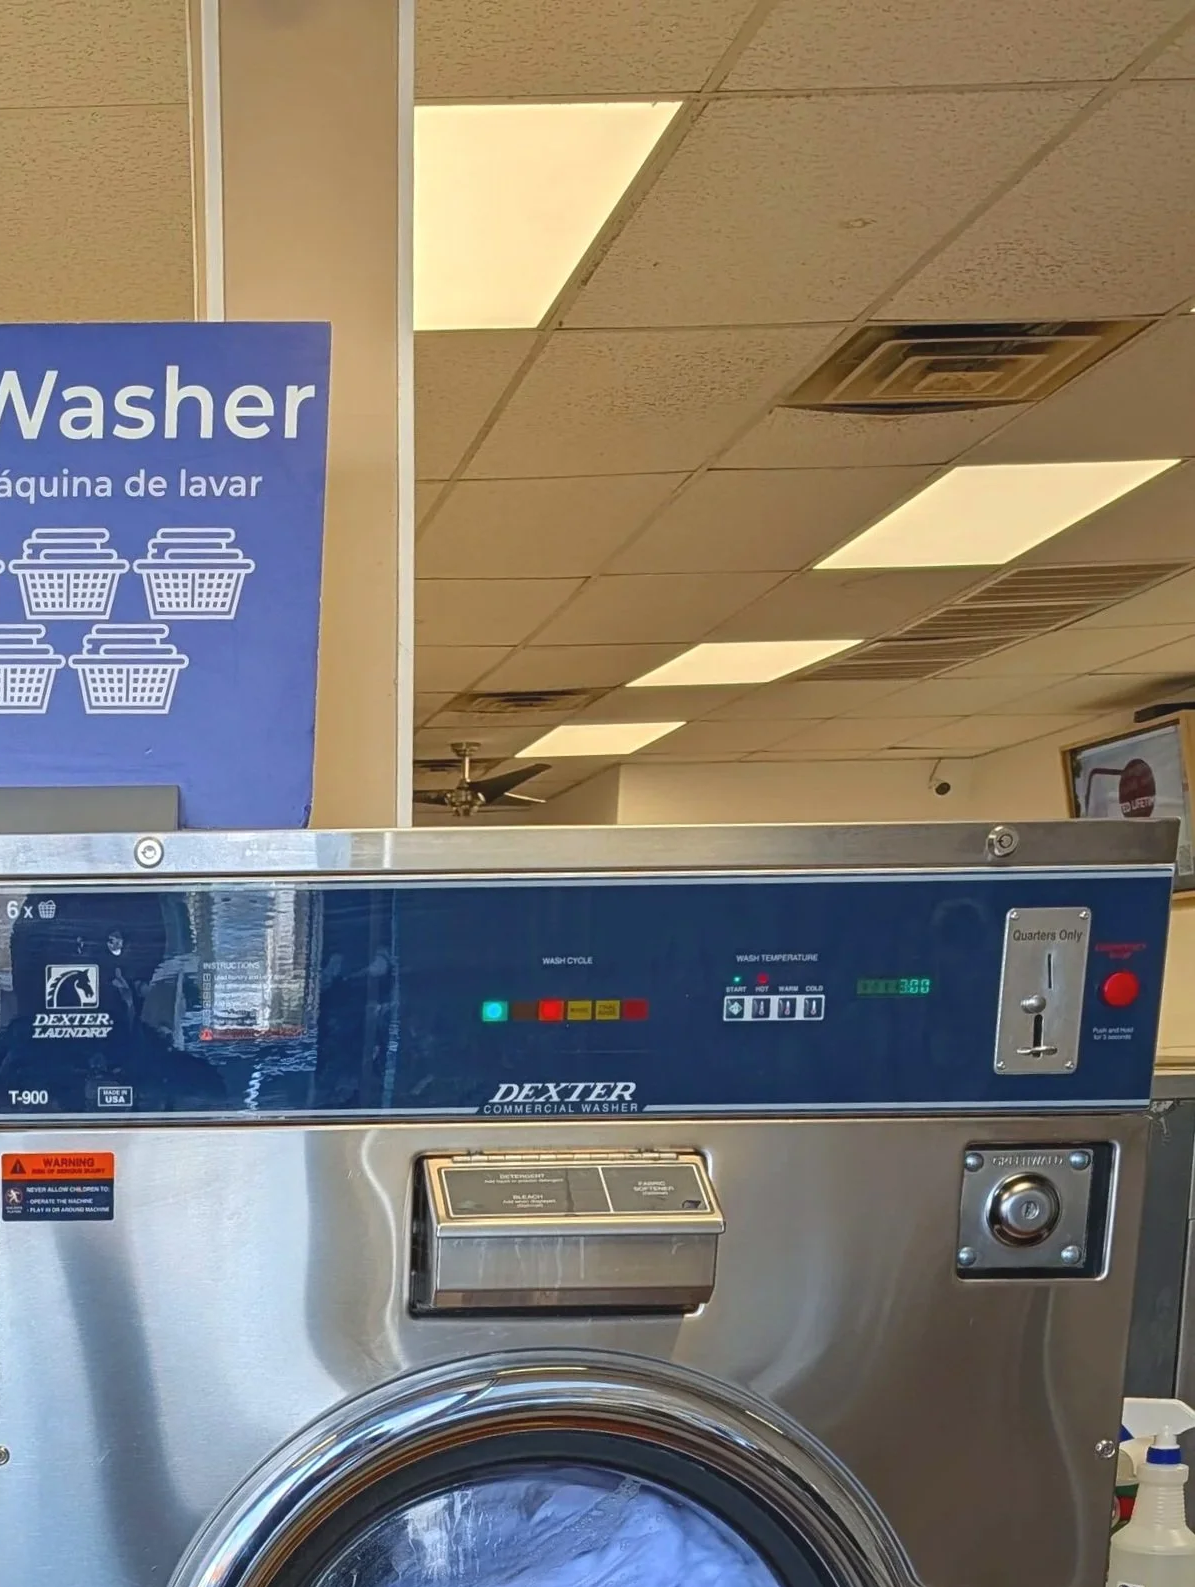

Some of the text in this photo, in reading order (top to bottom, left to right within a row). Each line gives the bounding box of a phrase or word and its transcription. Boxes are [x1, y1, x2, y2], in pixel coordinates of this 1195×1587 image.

[125, 469, 167, 498] de
[179, 469, 263, 498] lavar
[7, 900, 33, 919] 6 x
[1013, 929, 1083, 942] Quarters Only
[542, 957, 593, 965] WASH CYCLE
[736, 954, 819, 962] WASH TEMPERATURE
[202, 962, 260, 970] INSTRUCTIONS
[32, 1013, 109, 1026] DEXTER
[32, 1027, 113, 1039] LAUNDRY
[9, 1090, 48, 1105] T-900
[488, 1082, 637, 1103] DEXTER
[105, 1096, 125, 1104] USA
[483, 1103, 638, 1114] COMMERCIAL WASHER
[43, 1158, 95, 1168] WARNING
